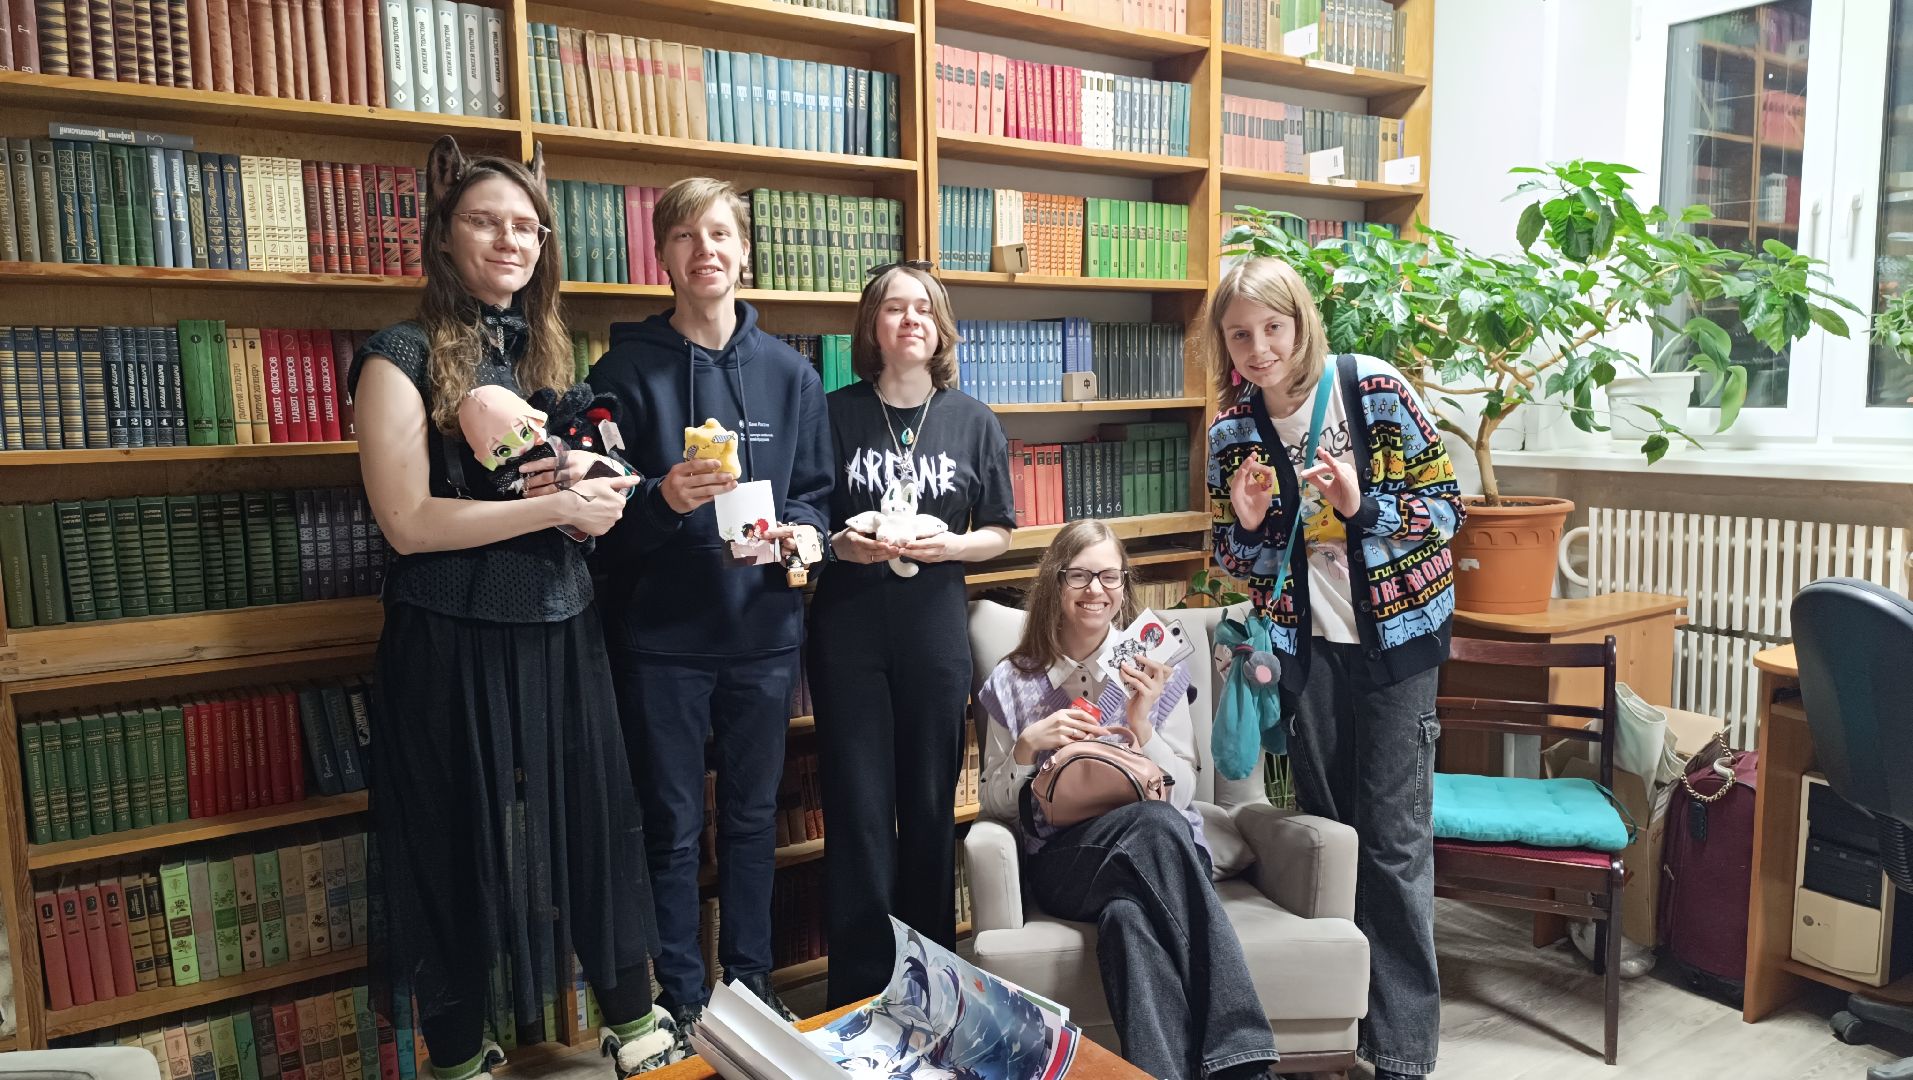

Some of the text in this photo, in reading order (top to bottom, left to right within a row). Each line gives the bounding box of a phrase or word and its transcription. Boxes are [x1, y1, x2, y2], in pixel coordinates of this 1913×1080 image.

[420, 48, 428, 74] АЛЕКСЕЙ
[470, 52, 478, 79] АЛЕКСЕЙ
[60, 126, 109, 141] Троепольский
[146, 134, 164, 144] 3
[42, 172, 54, 220] ТРИФОНОВ
[248, 184, 256, 213] ФАДЕЕВ
[265, 184, 274, 213] ФАДЕЕВ
[278, 186, 286, 214] ФАДЕЕВ
[292, 187, 301, 215] ФАДЕЕВ
[18, 171, 32, 253] ЮРИЙ ТРИФОНОВ
[352, 191, 361, 223] ФАДЕЕВ
[158, 231, 163, 245] 1
[178, 231, 187, 246] 2
[71, 248, 76, 257] 1
[90, 248, 97, 257] 2
[572, 247, 582, 258] 5
[592, 248, 600, 259] 6
[1015, 246, 1024, 268] Т
[232, 340, 238, 348] 1
[249, 341, 255, 349] 2
[284, 334, 295, 350] 2
[269, 357, 283, 424] ПАВЕЛ ФЕДОРОВ
[286, 357, 300, 423] ПАВЕЛ ФЕДОРОВ
[303, 356, 317, 421] ПАВЕЛ ФЕДОРОВ
[321, 357, 334, 421] ПАВЕЛ ФЕДОРОВ
[349, 424, 356, 434] 1
[844, 447, 957, 500] ARCANE
[1070, 507, 1073, 518] 1
[1077, 506, 1082, 515] 2
[1087, 504, 1092, 514] 3
[1096, 503, 1102, 514] 4
[1107, 502, 1112, 513] 5
[1115, 502, 1121, 512] 6
[88, 898, 95, 908] 3
[109, 894, 116, 904] 4
[45, 908, 50, 916] 1
[66, 903, 74, 913] 2
